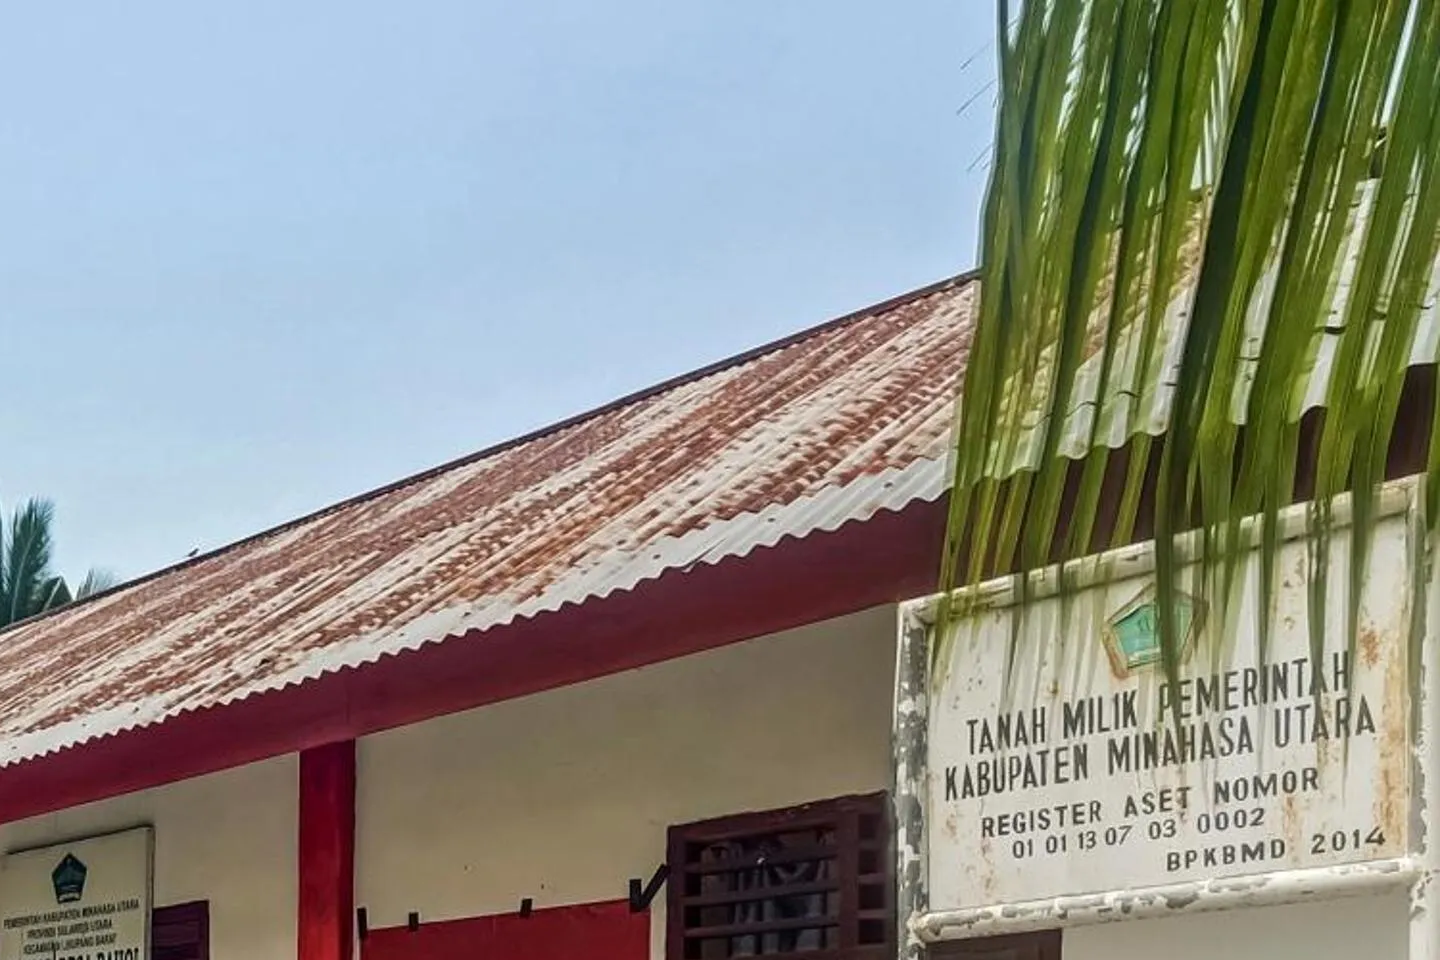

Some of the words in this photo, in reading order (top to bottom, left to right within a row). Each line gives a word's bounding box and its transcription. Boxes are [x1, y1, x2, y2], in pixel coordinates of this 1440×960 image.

[966, 706, 1047, 755] TANAH
[1062, 689, 1138, 740] MILIK
[1159, 650, 1349, 723] PEMERINTAH
[944, 743, 1088, 801] KABUPATEN
[1108, 715, 1254, 776] MINAHASA
[1274, 693, 1376, 748] UTARA
[981, 800, 1102, 838] REGISTER
[1123, 786, 1192, 818] ASET
[1214, 767, 1319, 806] NOMOR
[1012, 838, 1033, 859] 01
[1045, 834, 1067, 854] 01
[1078, 830, 1097, 850] 13
[1105, 824, 1132, 846] 07
[1148, 818, 1177, 840] 03
[1196, 807, 1265, 834] 0002
[1166, 838, 1286, 872] BPKBMD
[1310, 825, 1386, 855] 2014
